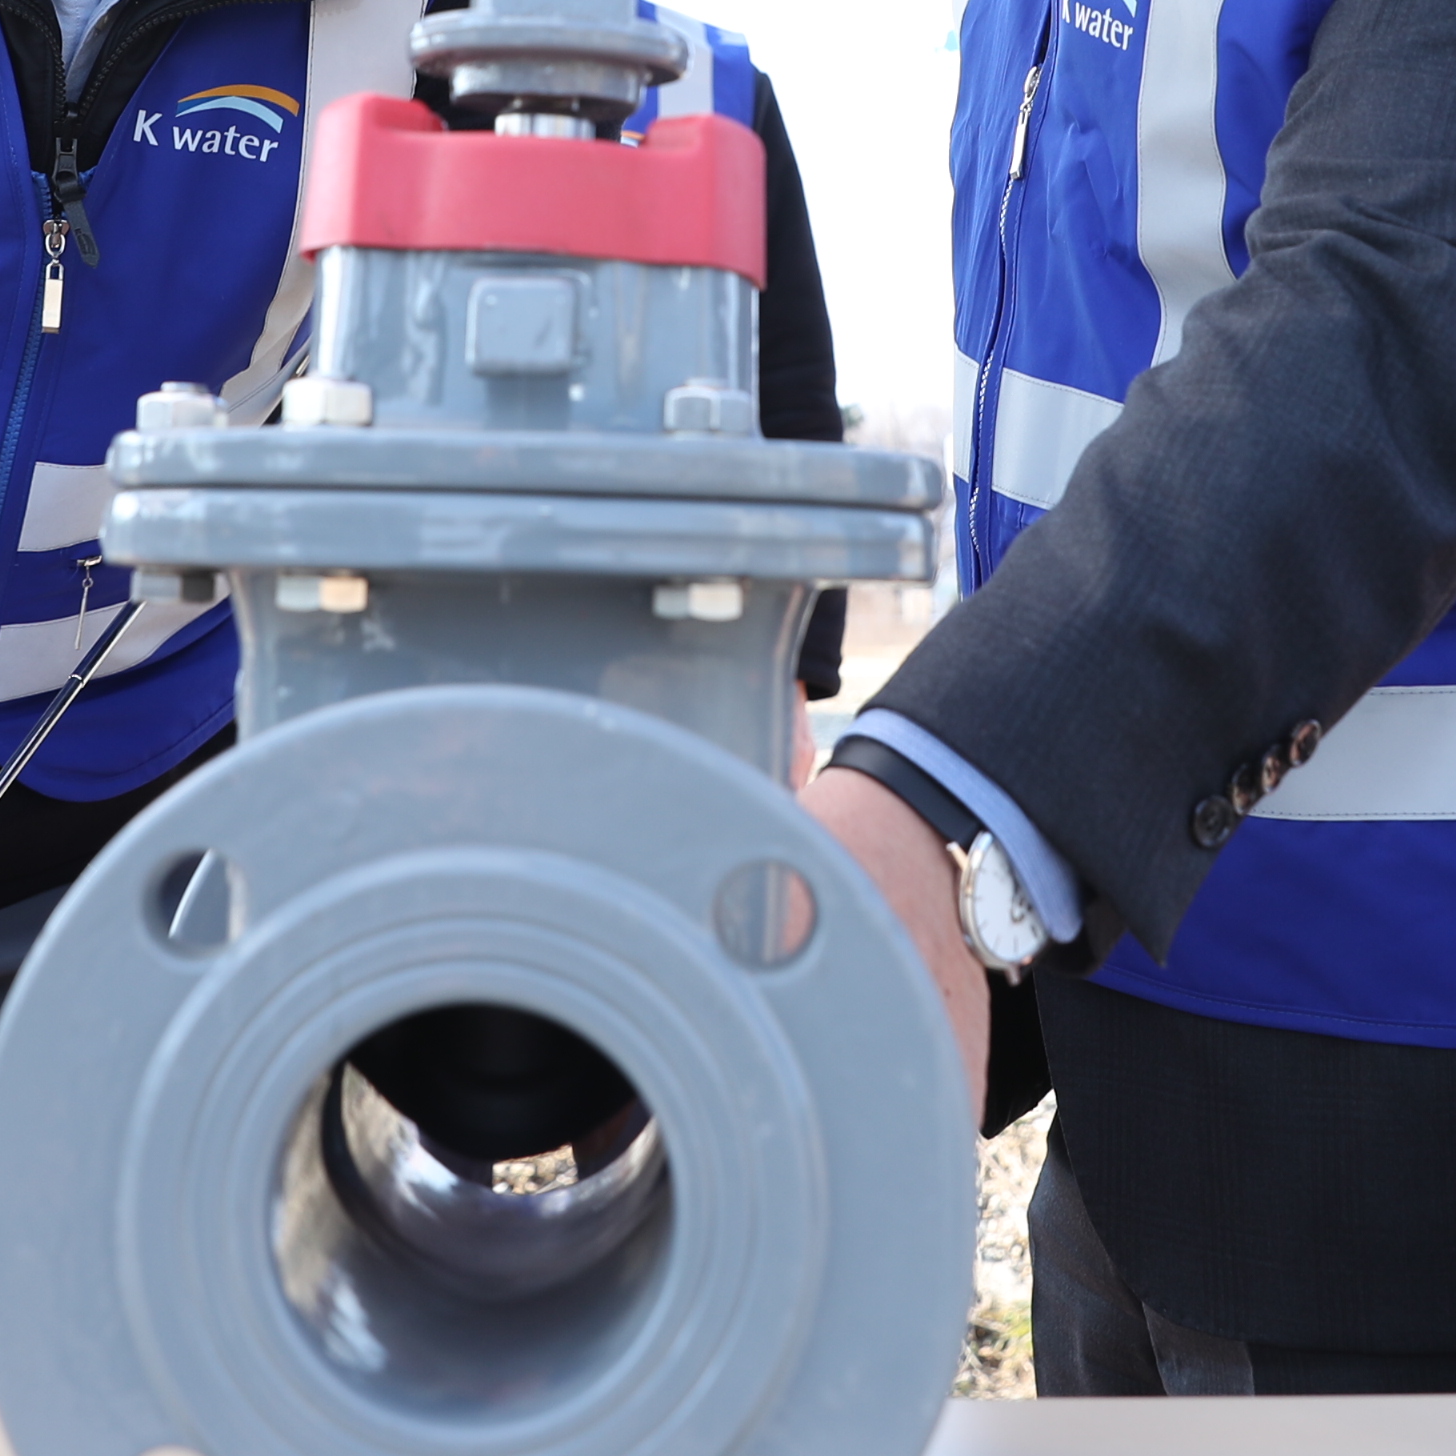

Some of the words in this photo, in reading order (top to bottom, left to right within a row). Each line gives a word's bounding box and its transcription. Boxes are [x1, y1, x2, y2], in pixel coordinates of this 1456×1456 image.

[1075, 2, 1133, 51] water
[133, 109, 162, 146] K
[172, 125, 279, 162] water
